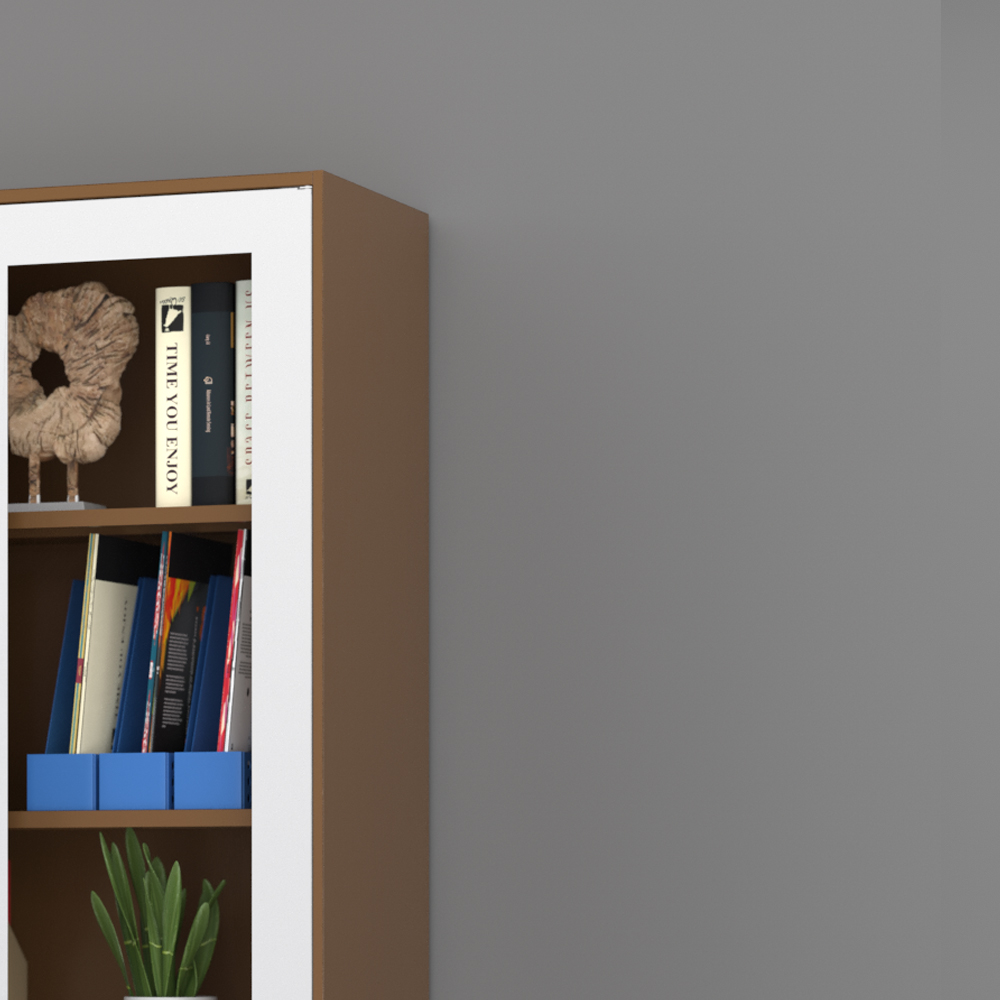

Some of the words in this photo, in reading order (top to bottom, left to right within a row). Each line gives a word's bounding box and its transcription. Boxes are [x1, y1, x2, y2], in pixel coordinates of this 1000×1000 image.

[166, 342, 178, 389] TIME
[166, 393, 178, 431] YOU
[166, 437, 178, 495] ENJOY
